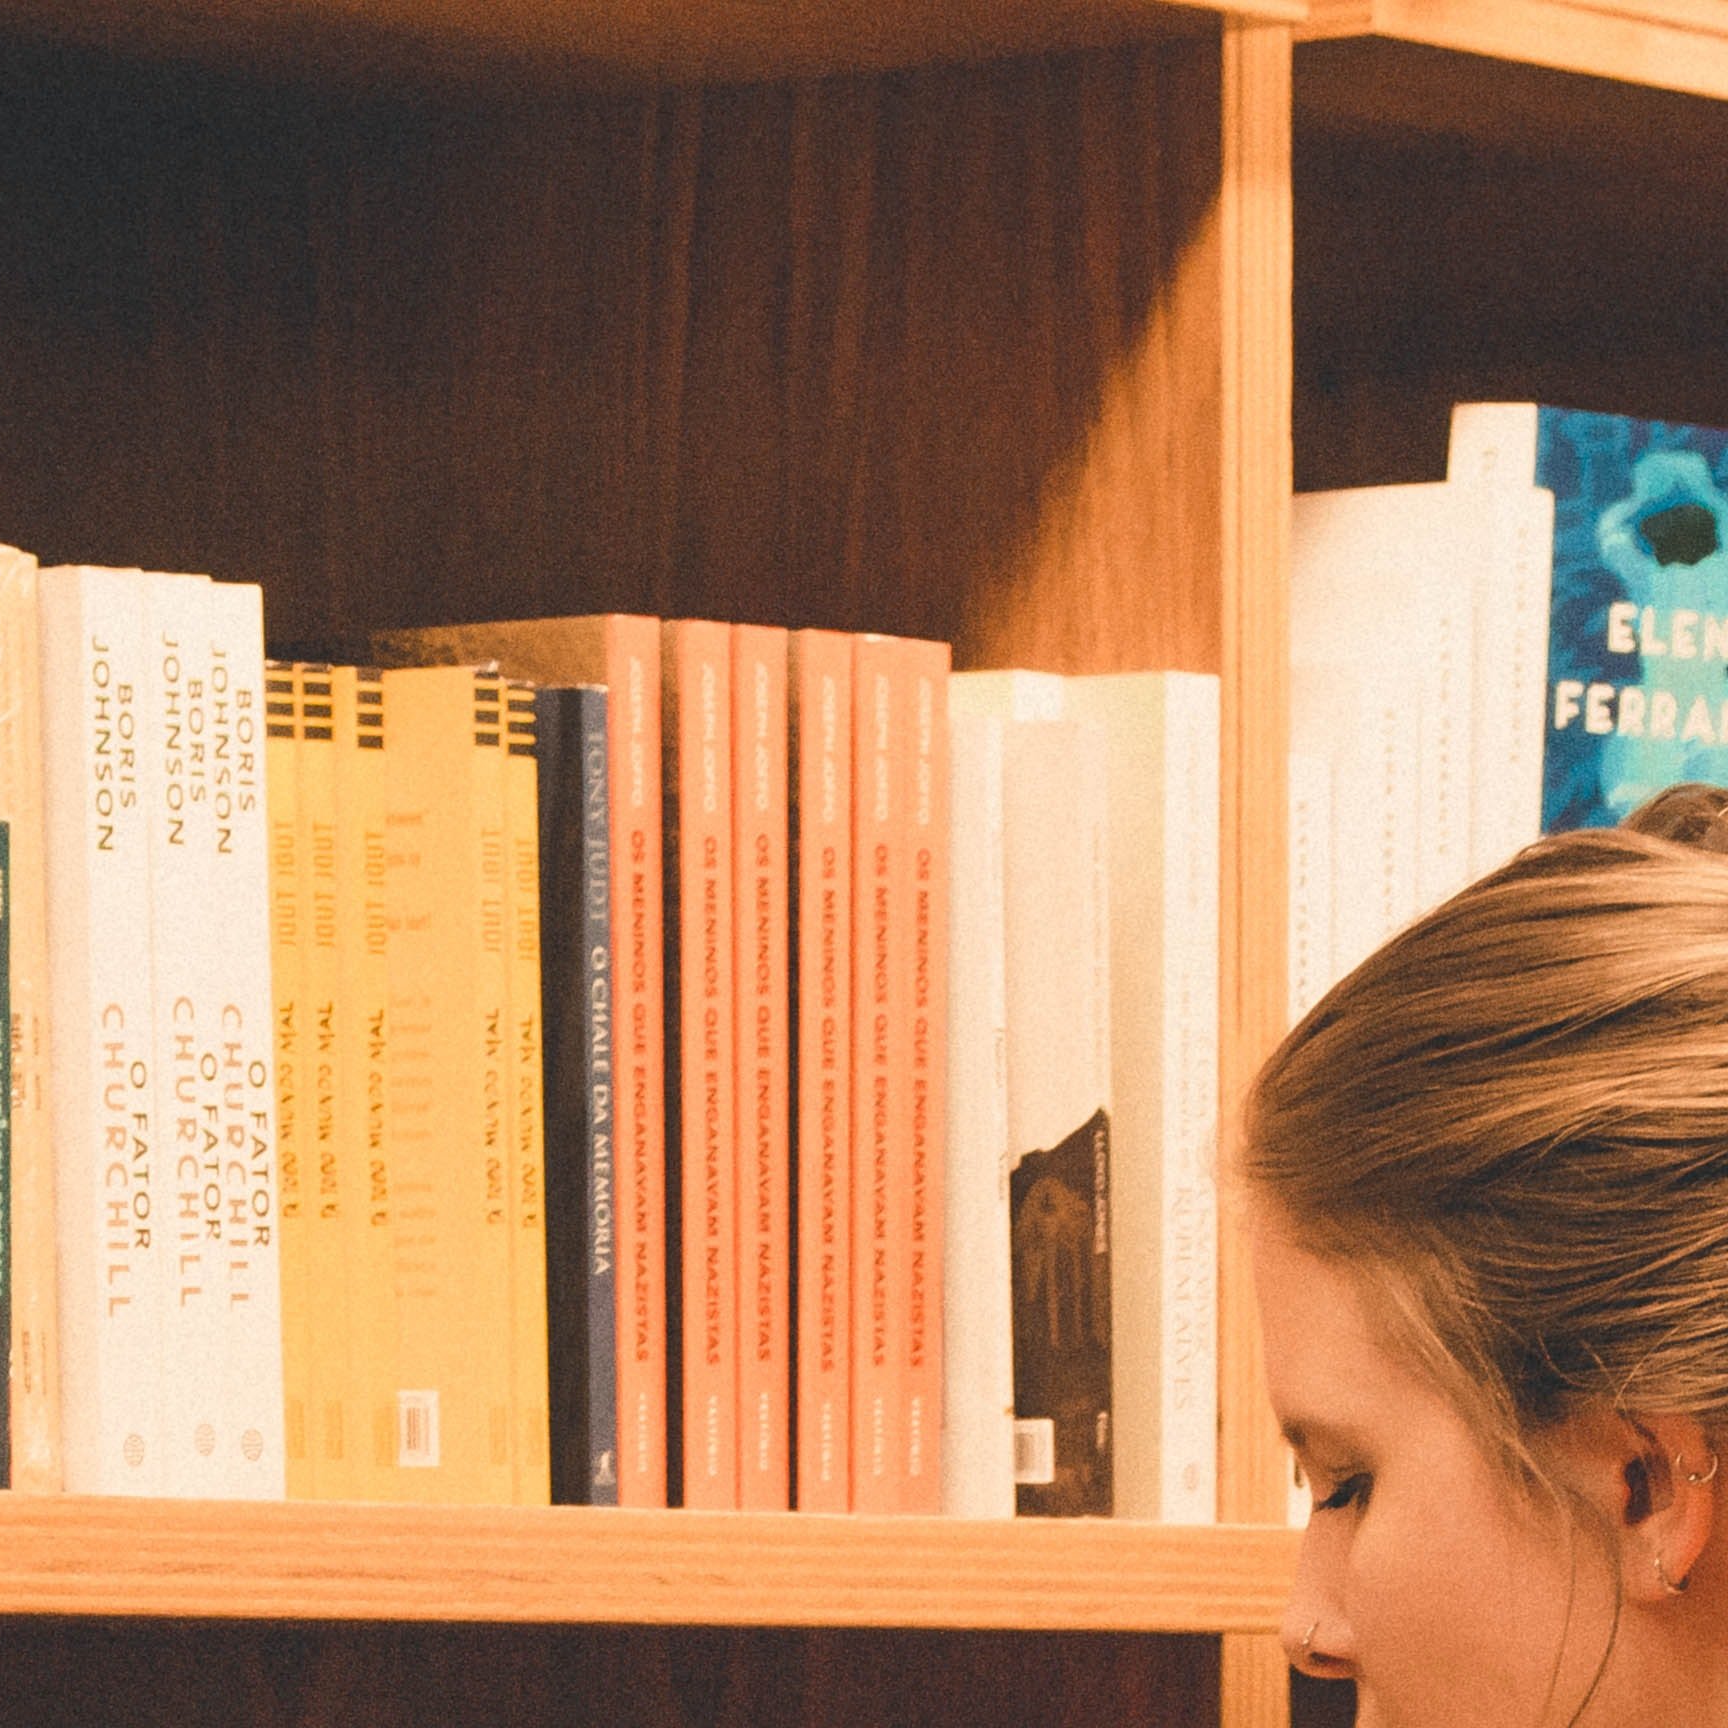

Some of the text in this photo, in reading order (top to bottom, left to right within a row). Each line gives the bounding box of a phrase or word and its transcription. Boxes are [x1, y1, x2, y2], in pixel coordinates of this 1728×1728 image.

[91, 635, 114, 851] JOHNSON
[118, 683, 136, 809] BORIS
[591, 945, 608, 970] O
[101, 1003, 131, 1318] CHURCHILL
[130, 1060, 152, 1251] O FATOR
[593, 1084, 610, 1124] DA
[631, 830, 649, 1362] OS MENINOS QUE ENGANAVAM NAZISTAS
